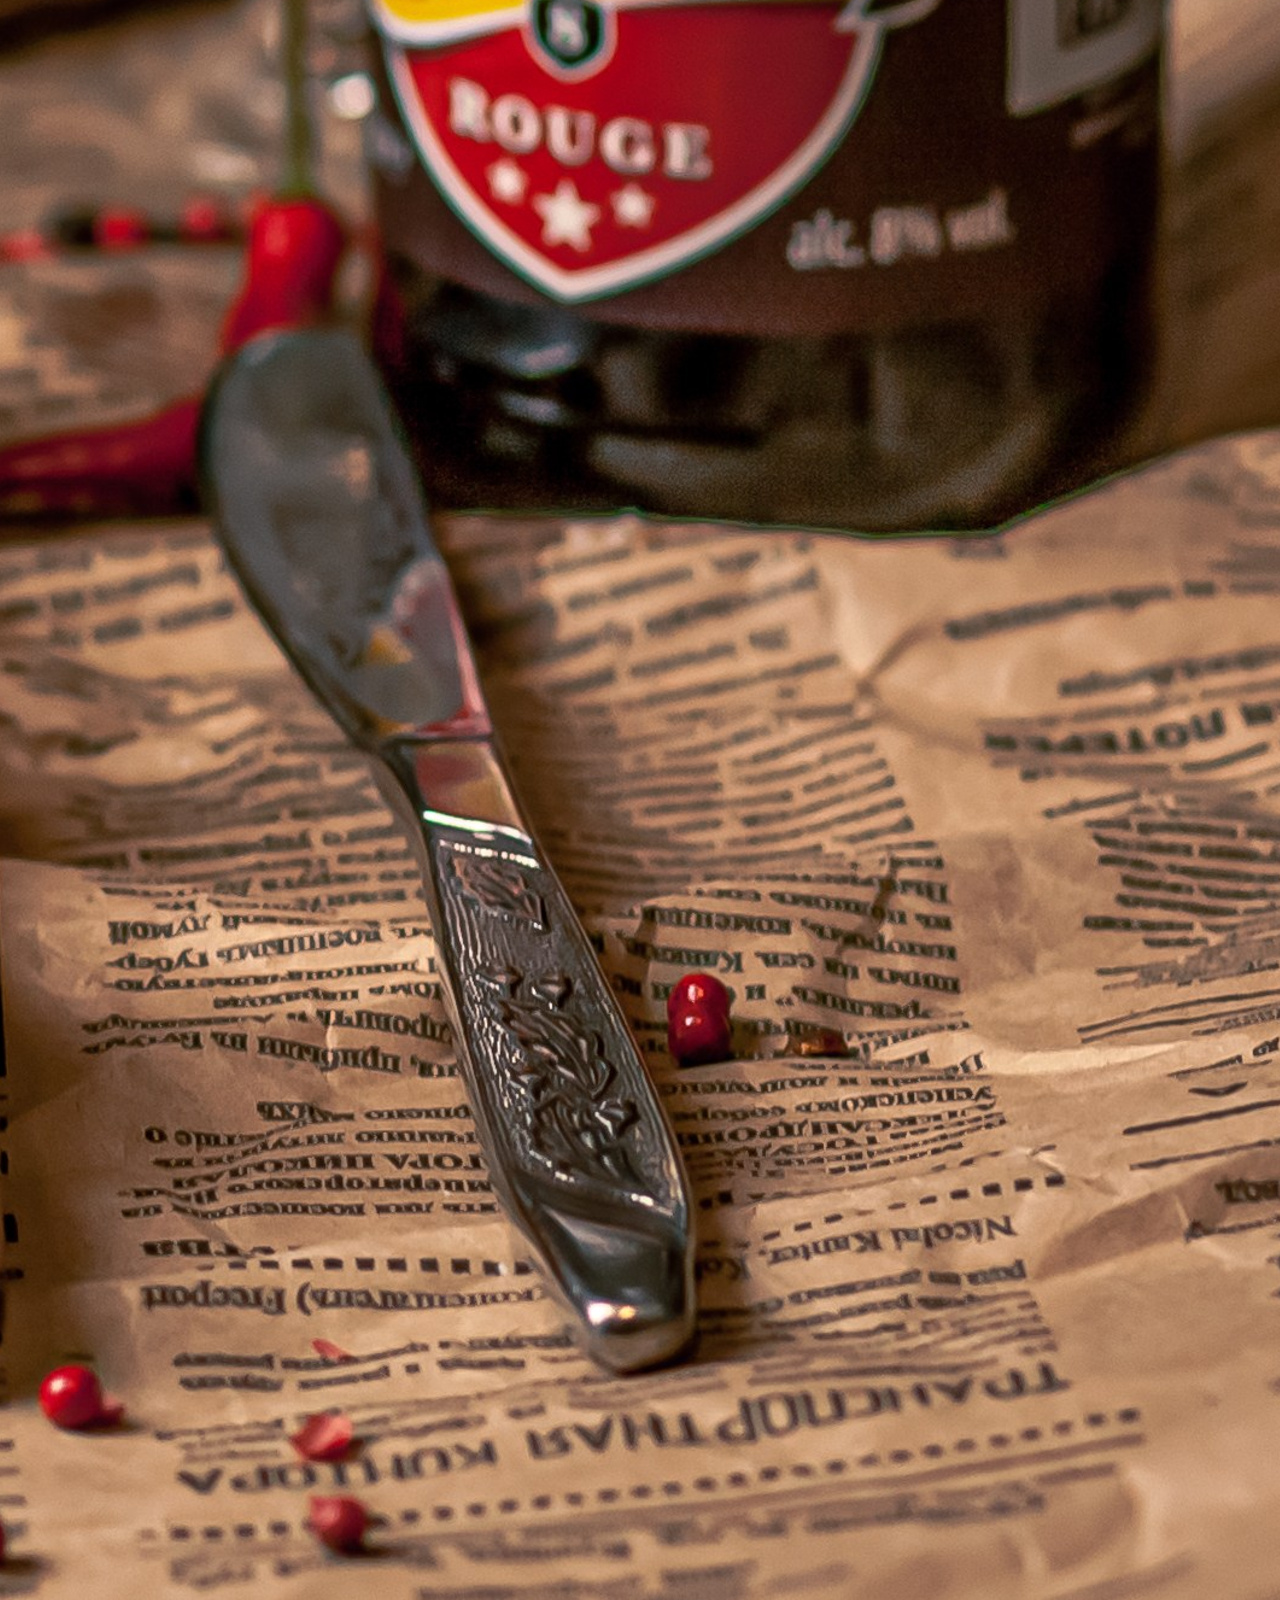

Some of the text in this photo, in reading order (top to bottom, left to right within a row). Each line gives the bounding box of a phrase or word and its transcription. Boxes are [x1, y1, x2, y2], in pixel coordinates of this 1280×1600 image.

[449, 76, 713, 181] ROUGE
[891, 1215, 1015, 1252] Nicolai
[139, 1280, 285, 1316] Freeport
